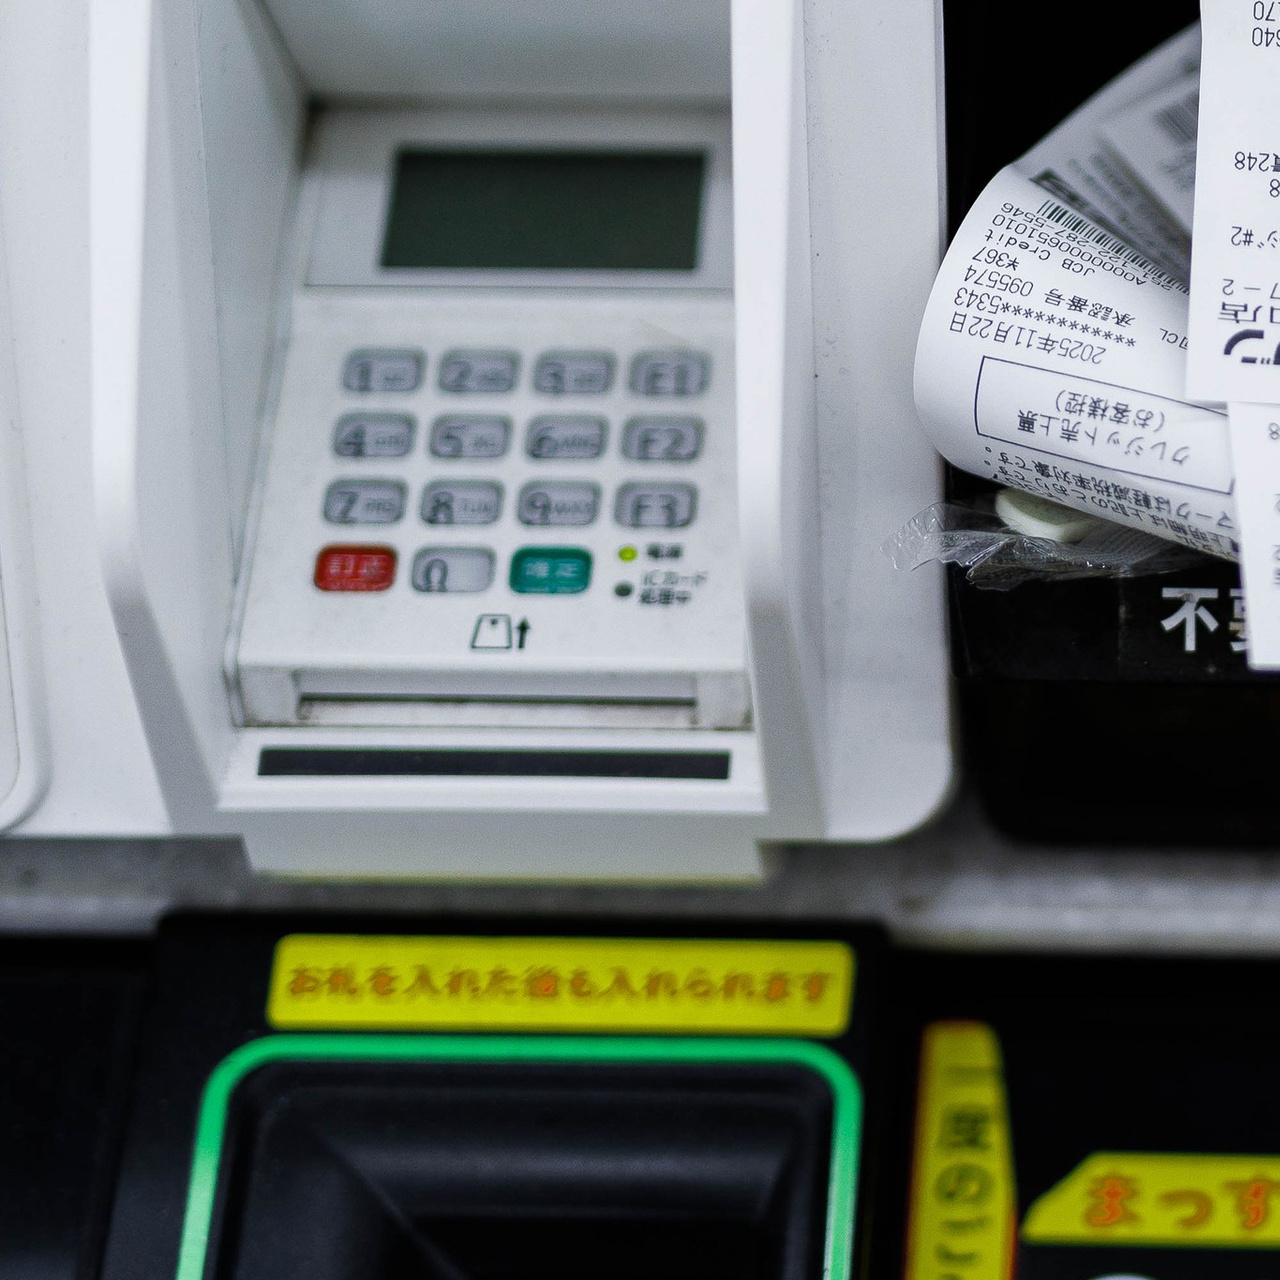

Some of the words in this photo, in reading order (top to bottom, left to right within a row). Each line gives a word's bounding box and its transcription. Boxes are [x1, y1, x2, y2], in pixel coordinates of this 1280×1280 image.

[972, 246, 1019, 271] ¥367
[985, 229, 1050, 260] Credit
[964, 265, 1033, 296] 095574
[1061, 258, 1095, 276] JCB
[1044, 289, 1135, 327] 承認番号
[950, 311, 1106, 364] 2025年11月22日
[1017, 410, 1190, 465] クレジット売上票
